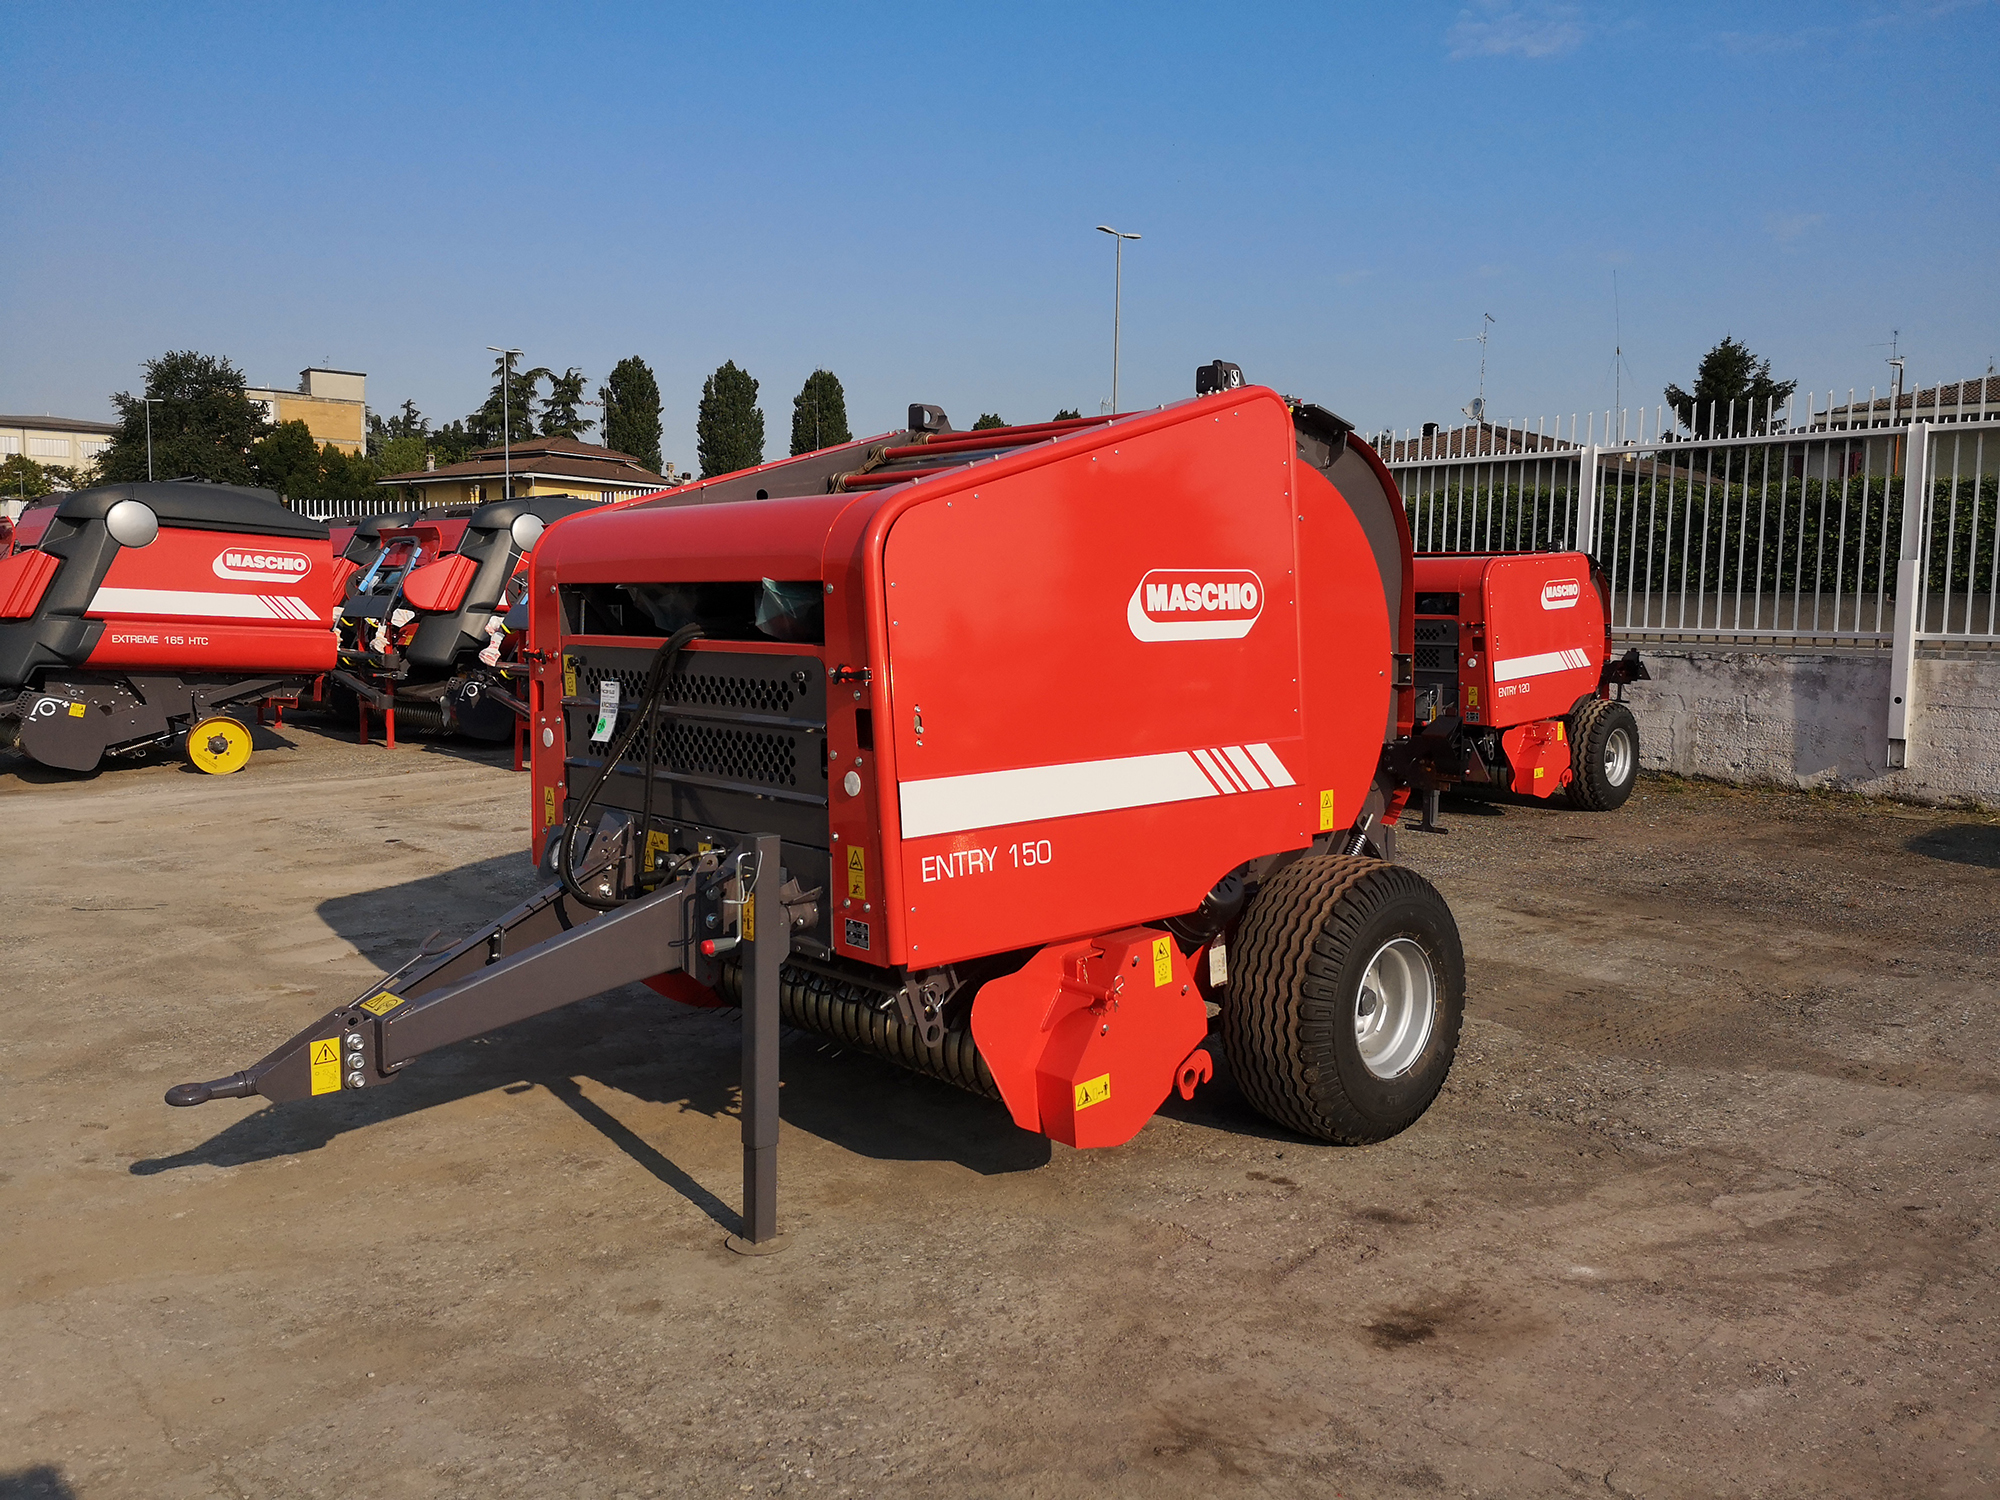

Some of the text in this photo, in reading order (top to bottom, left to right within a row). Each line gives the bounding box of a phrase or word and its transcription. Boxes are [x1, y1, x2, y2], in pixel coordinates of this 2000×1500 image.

[226, 553, 307, 572] MASCHIO
[1146, 582, 1258, 612] MASCHIO
[1546, 583, 1578, 598] MASCHIO
[111, 634, 209, 646] EXTREME 165 HTC
[1498, 682, 1530, 698] ENTRY 120
[921, 839, 1052, 883] ENTRY 150
